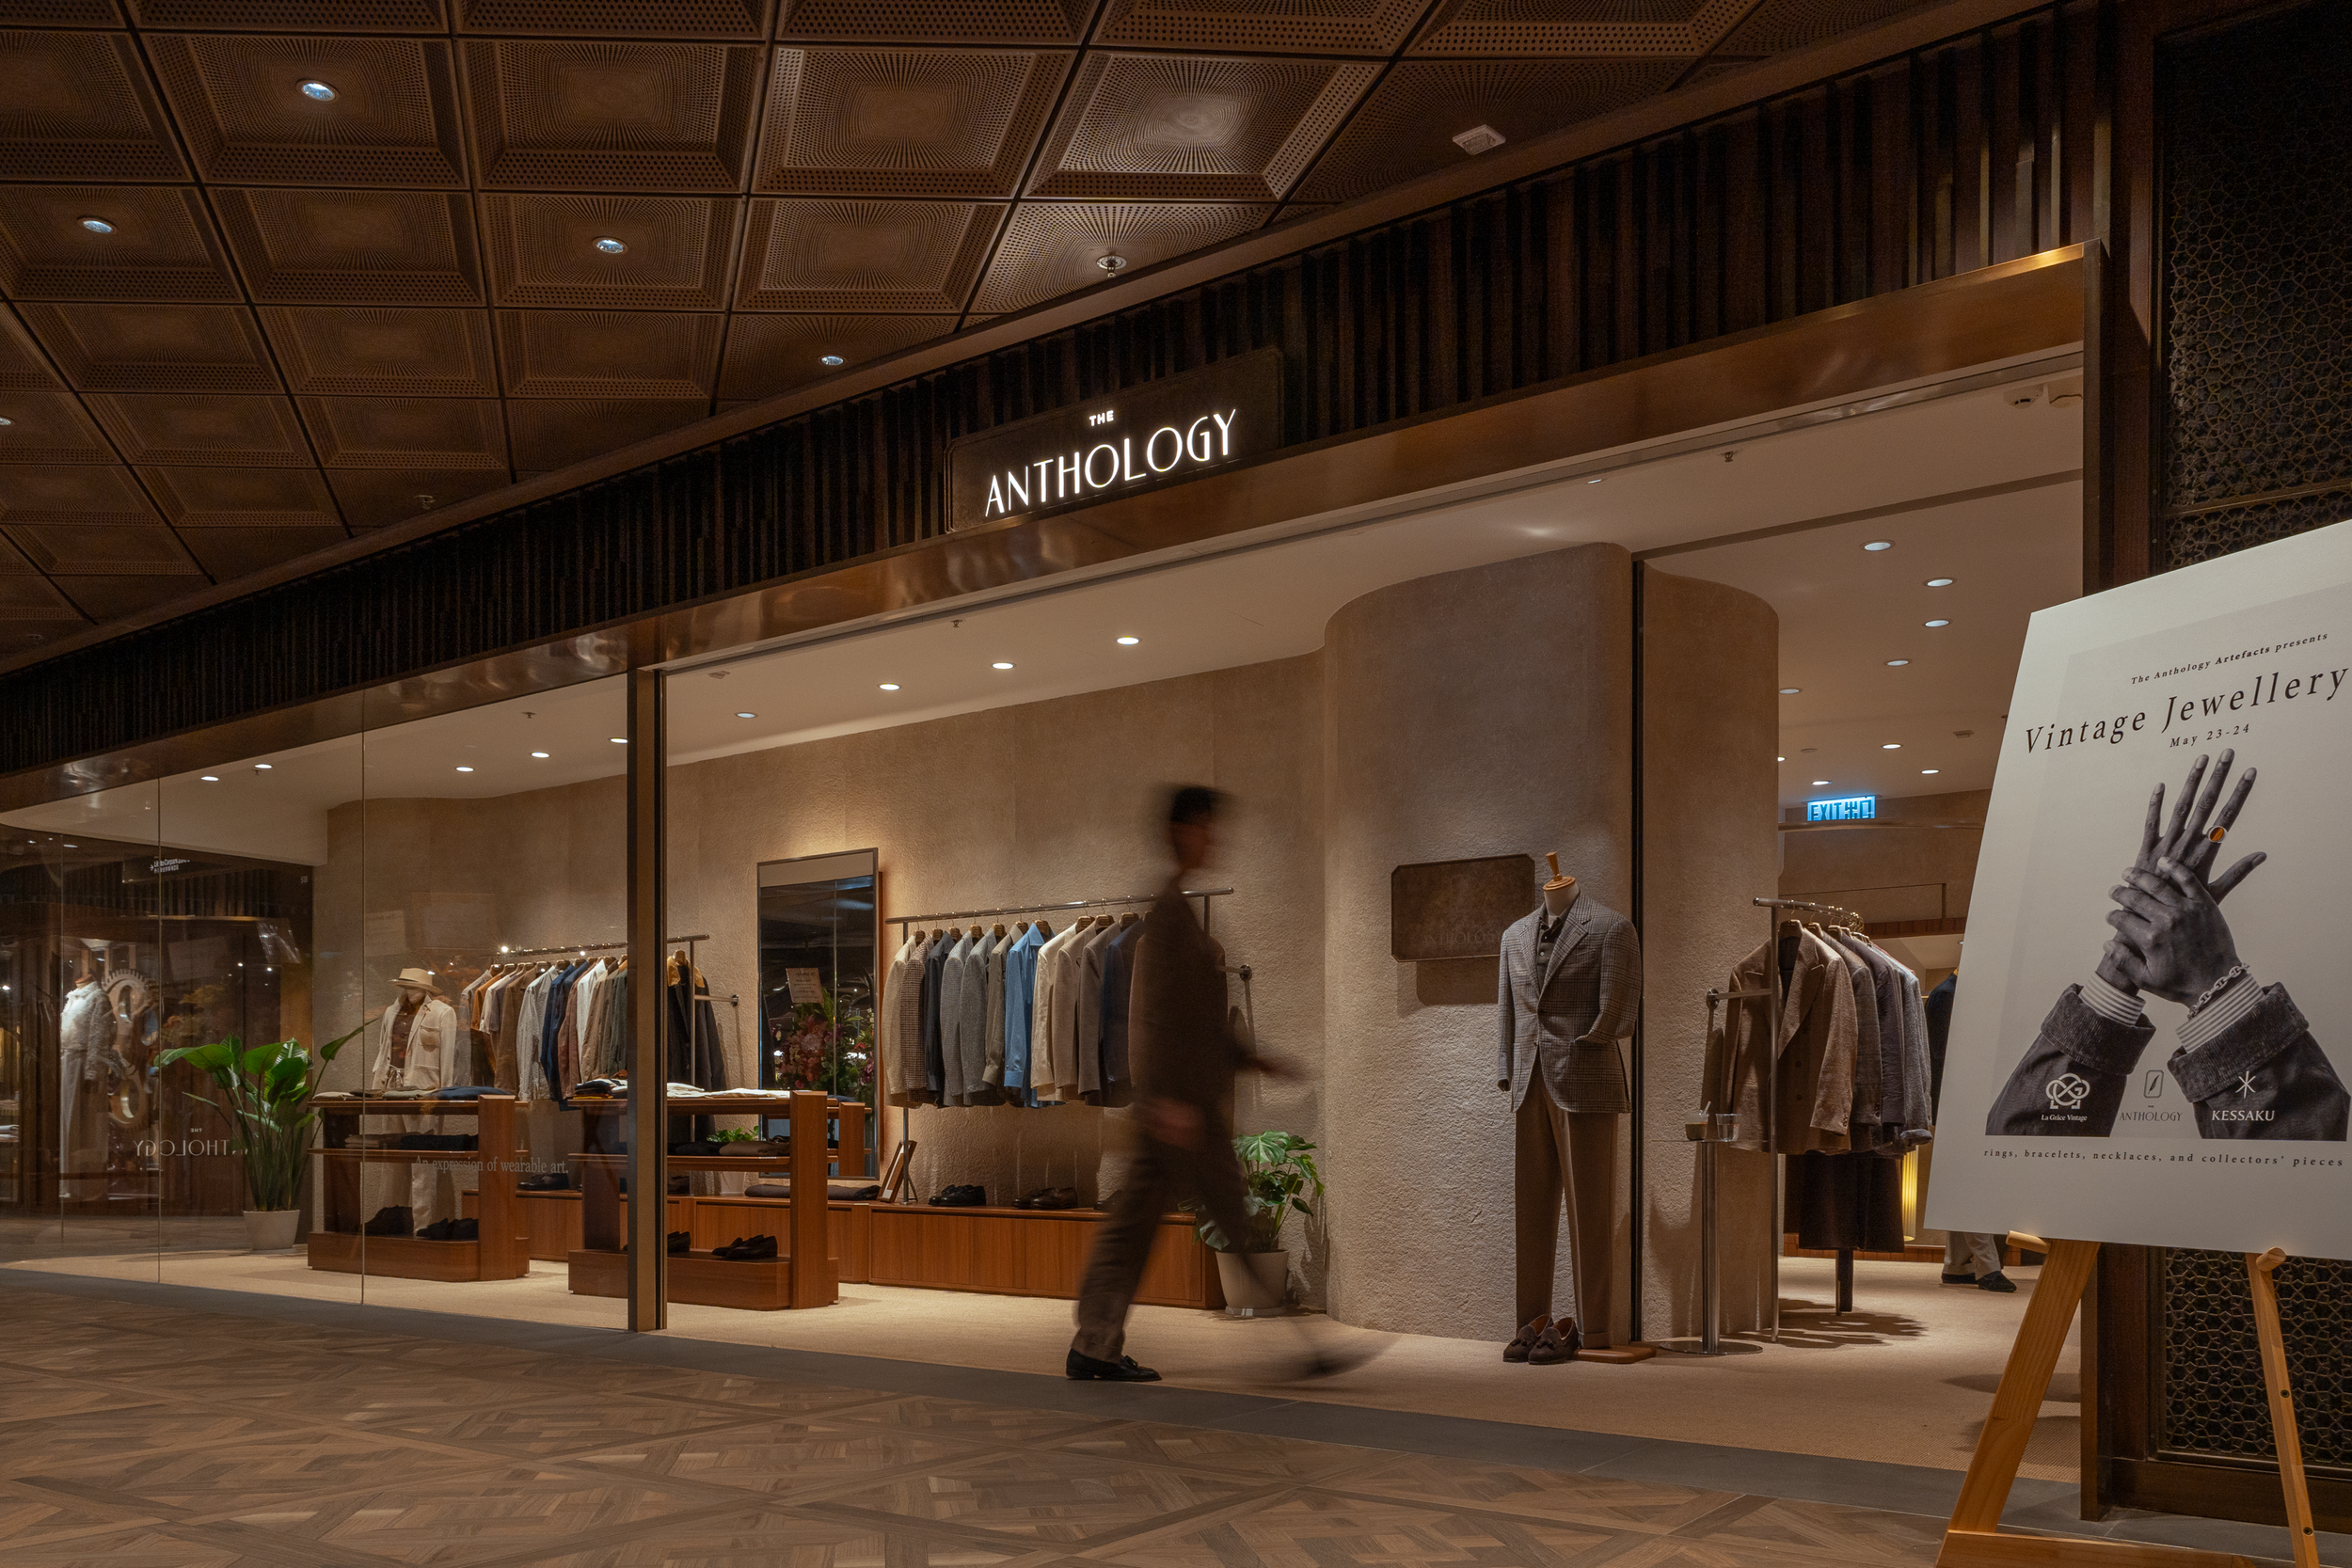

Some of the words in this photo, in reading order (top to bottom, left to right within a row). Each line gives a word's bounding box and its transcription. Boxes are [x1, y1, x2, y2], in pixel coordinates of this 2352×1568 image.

[1089, 409, 1115, 427] THE
[985, 408, 1236, 517] ANTHOLOGY
[2131, 675, 2150, 685] The
[2153, 660, 2211, 680] Anthology
[2216, 647, 2270, 665] Artefacts
[2275, 633, 2328, 654] presents
[2026, 712, 2146, 753] Vintage
[2161, 668, 2348, 734] Jewellery
[2169, 736, 2198, 748] May
[2206, 723, 2250, 741] 23-24
[1810, 801, 1842, 821] EXIT
[2067, 1114, 2088, 1123] Vintage
[2120, 1111, 2183, 1122] ANTHOLOGY
[2212, 1110, 2275, 1122] KESSAKU
[432, 1156, 484, 1174] expression
[486, 1156, 499, 1172] of
[500, 1156, 548, 1173] wearable
[550, 1161, 569, 1174] art.
[1983, 1149, 2019, 1160] rings,
[2024, 1149, 2087, 1161] bracelets,
[2092, 1151, 2163, 1163] necklaces,
[2169, 1153, 2194, 1163] and
[2293, 1156, 2344, 1168] pieces
